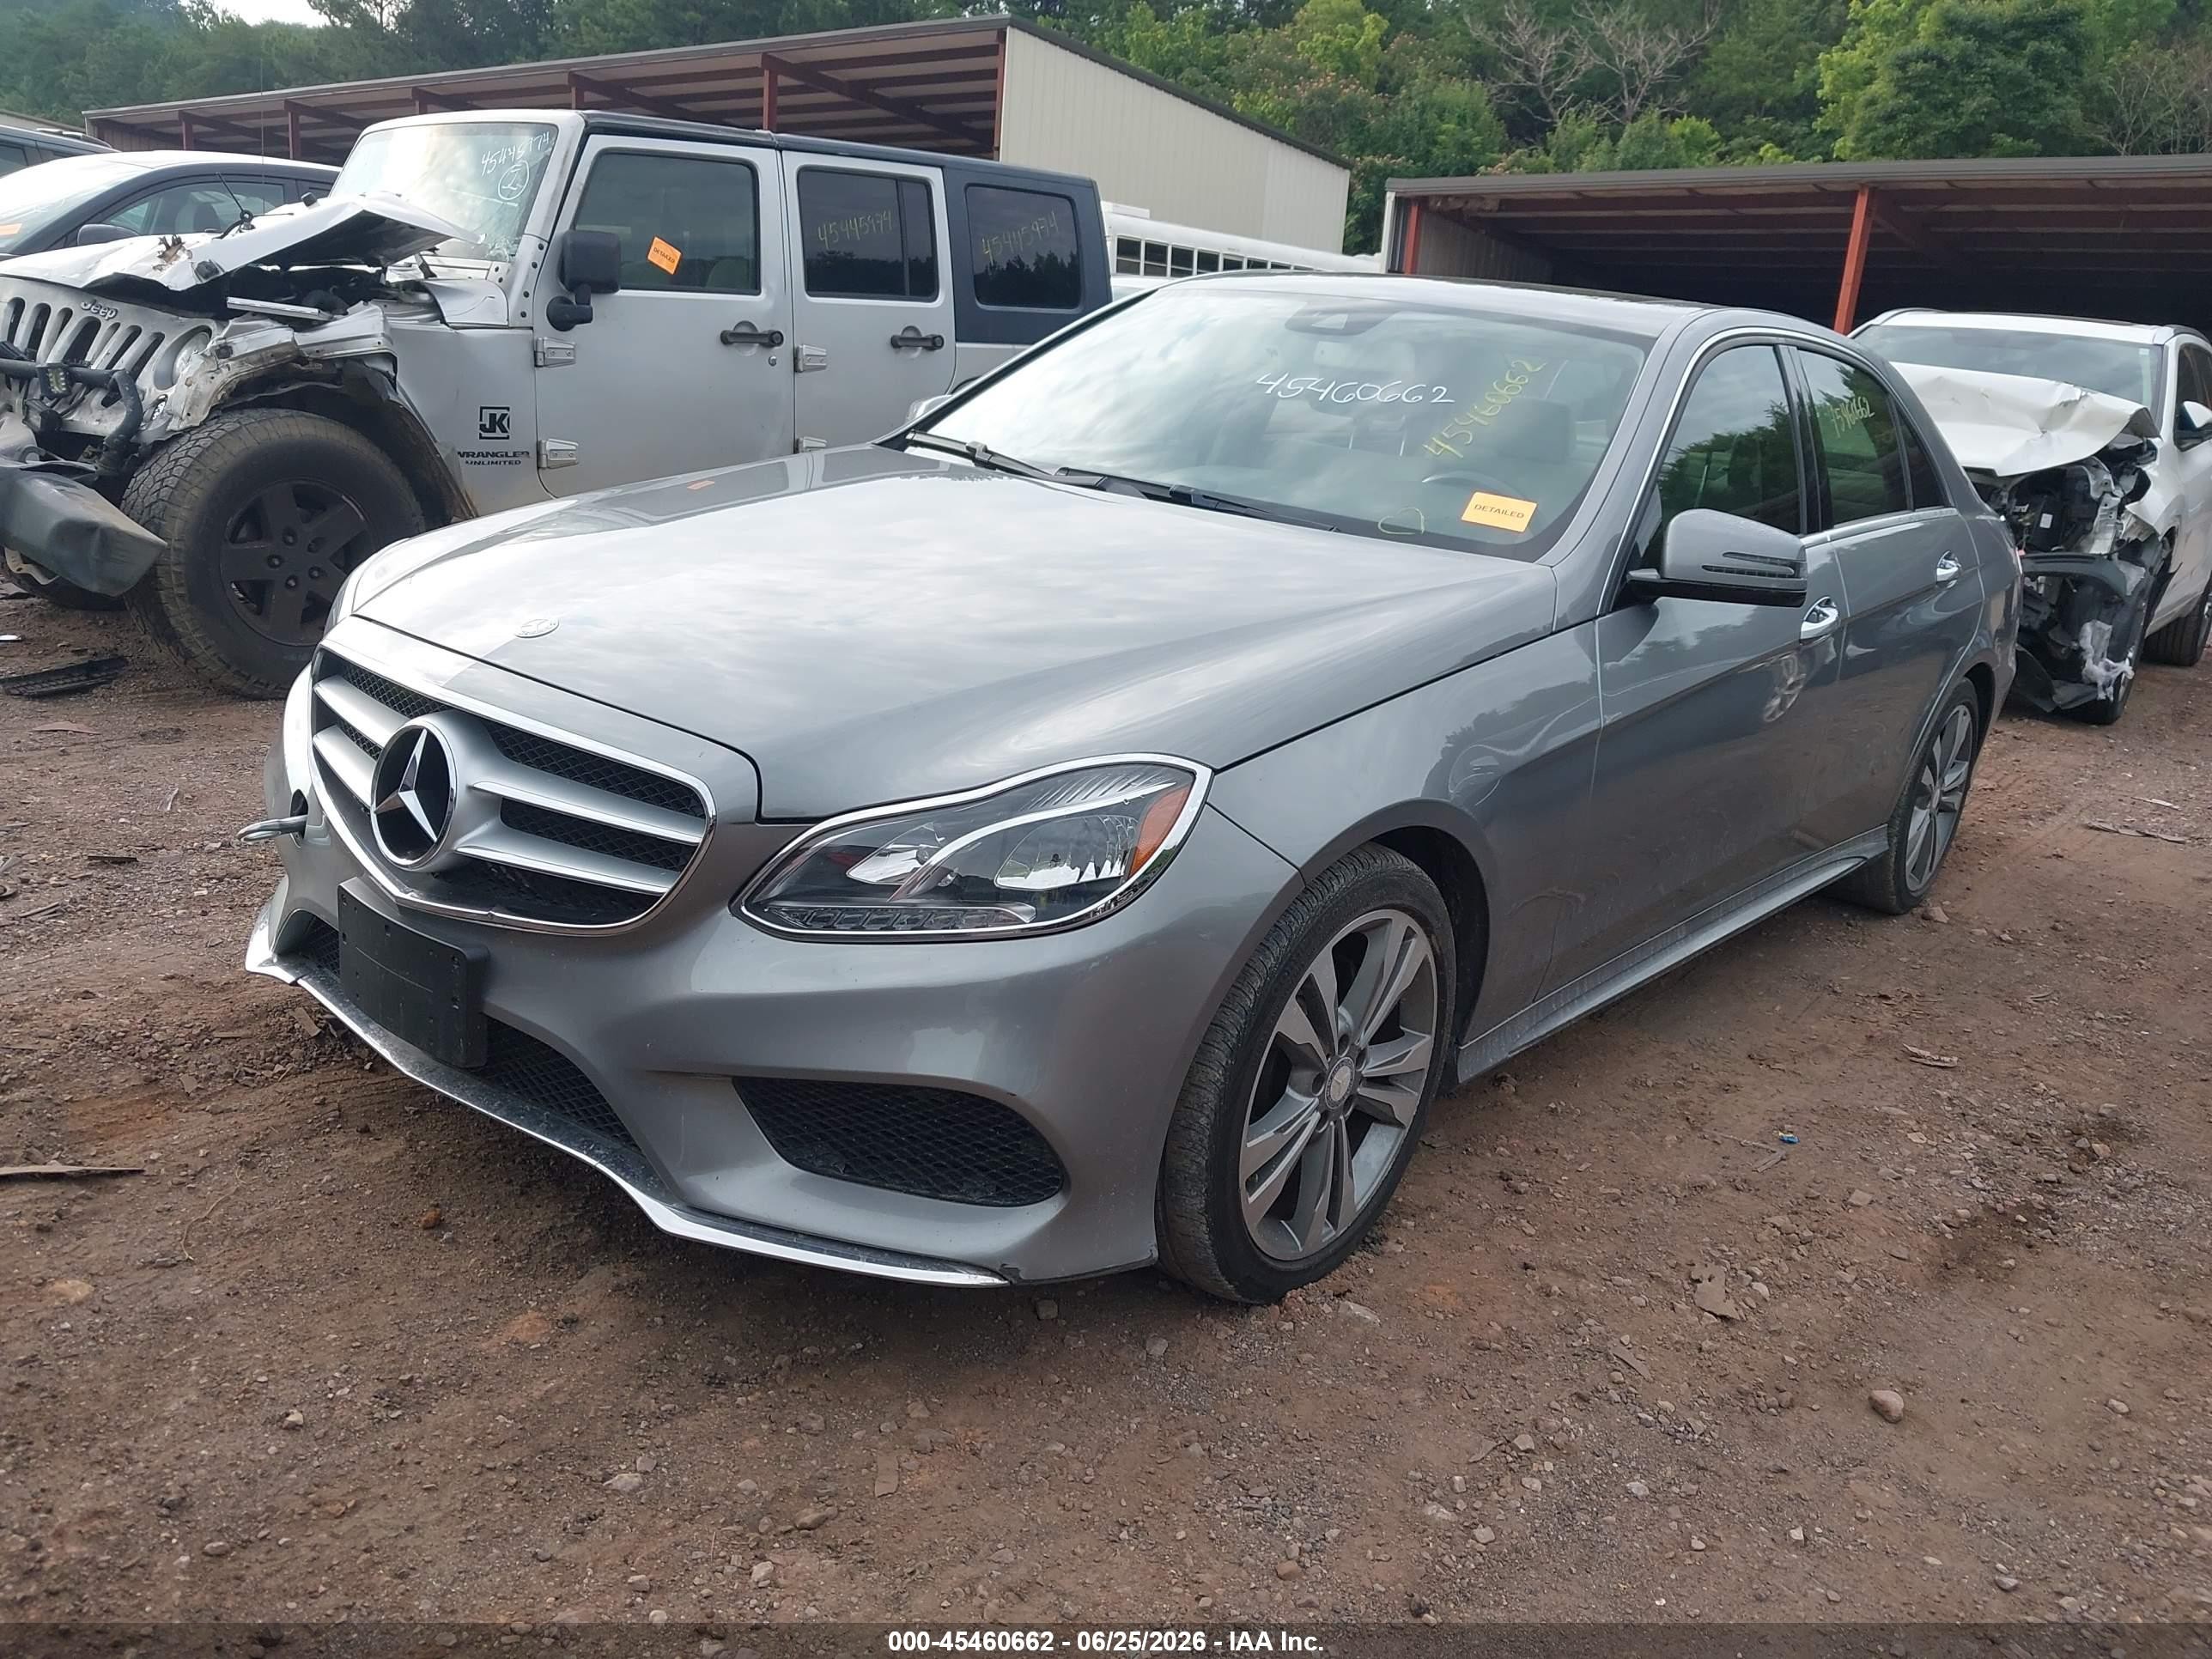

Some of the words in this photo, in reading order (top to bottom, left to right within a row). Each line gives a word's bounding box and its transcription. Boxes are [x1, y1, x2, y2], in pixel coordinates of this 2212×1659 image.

[80, 301, 118, 320] Jeep
[1256, 372, 1455, 404] 45460662
[1421, 359, 1547, 459] 45460662
[479, 412, 510, 434] JK
[1473, 503, 1525, 520] DETAILED
